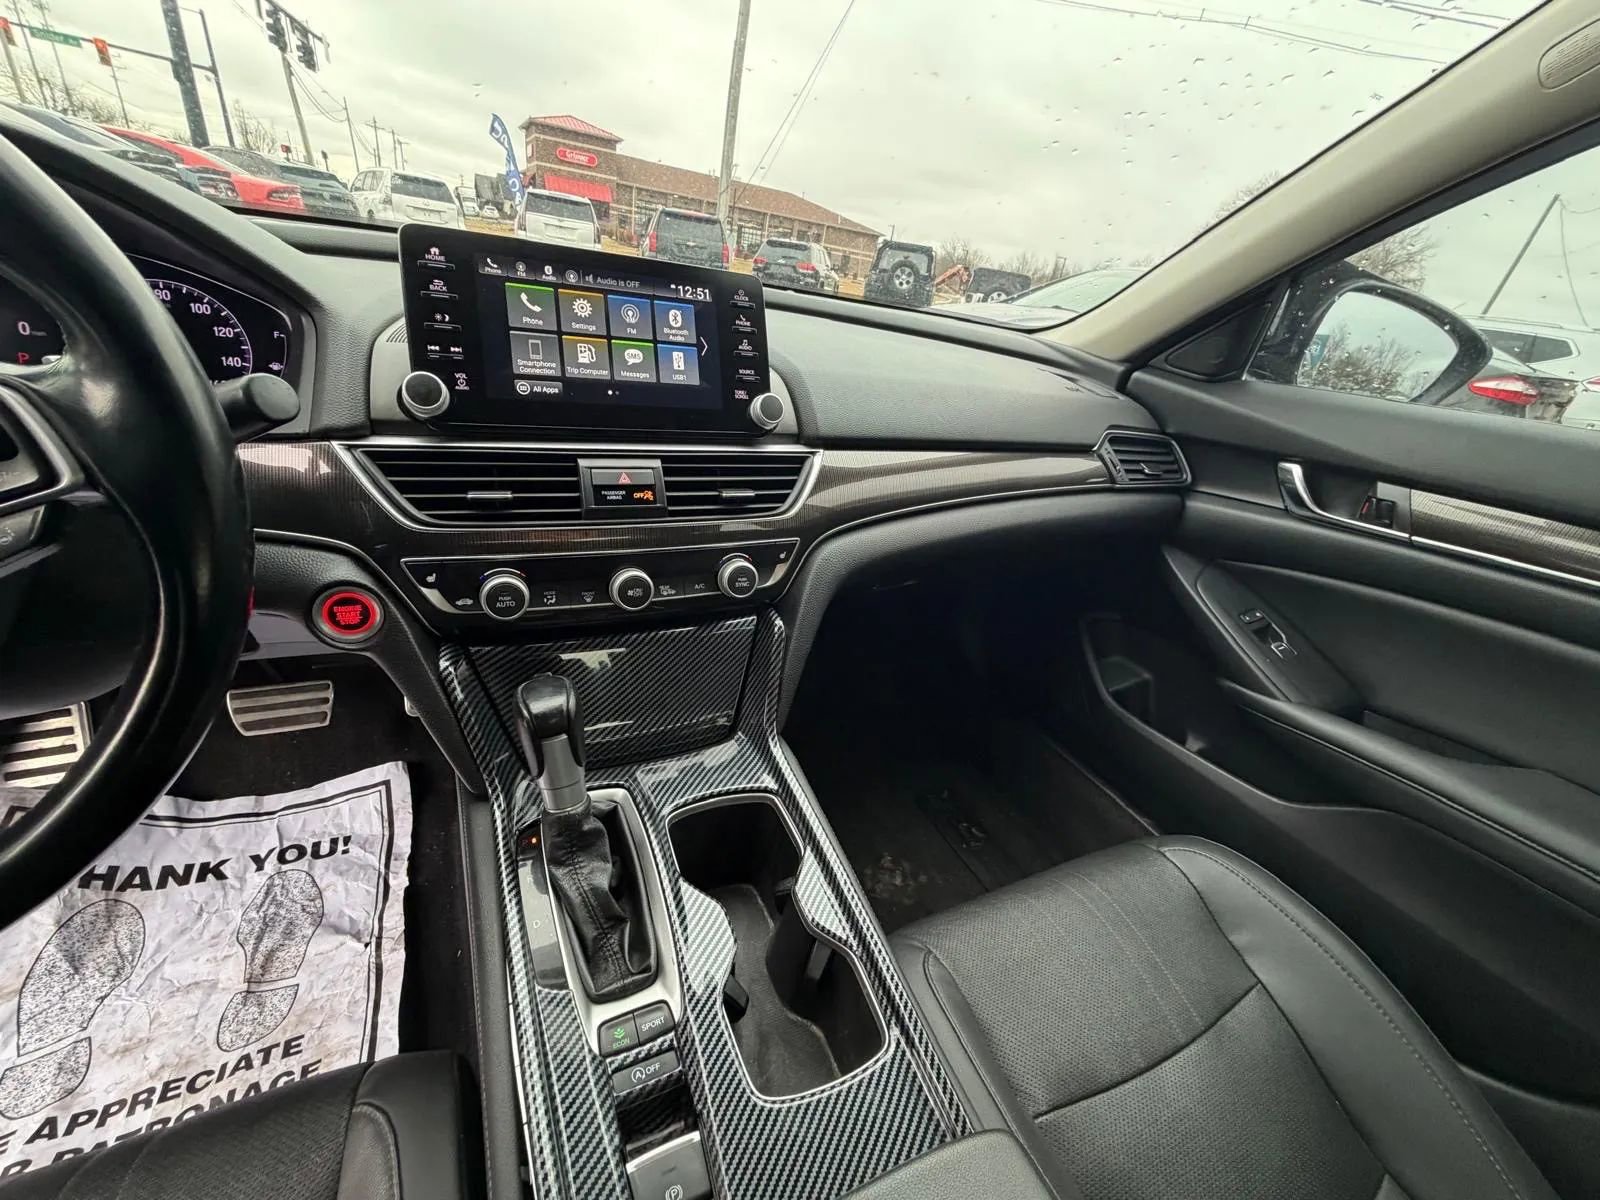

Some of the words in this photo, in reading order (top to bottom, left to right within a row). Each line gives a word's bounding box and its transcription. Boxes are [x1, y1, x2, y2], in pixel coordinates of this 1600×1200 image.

[425, 253, 446, 262] HOME
[484, 266, 502, 274] Phone
[596, 277, 618, 287] Audio
[618, 280, 625, 288] is
[626, 280, 641, 289] OFF
[429, 284, 448, 293] BACK
[677, 284, 711, 301] 12:51
[734, 294, 749, 302] CLOCK
[189, 302, 212, 315] 100
[522, 316, 544, 326] Phone
[735, 319, 751, 327] PHONE
[17, 320, 31, 336] 0
[571, 321, 597, 332] Settings
[626, 327, 637, 335] FM
[663, 327, 689, 336] Bluetooth
[212, 325, 235, 339] 120
[273, 331, 280, 339] F
[17, 352, 30, 364] P
[220, 356, 242, 368] 140
[517, 358, 557, 368] Smartphone
[519, 366, 556, 375] Connection
[566, 366, 578, 375] Trip
[579, 367, 609, 376] Computer
[620, 369, 650, 379] Messages
[533, 385, 542, 394] All
[542, 386, 559, 395] Apps
[495, 600, 516, 608] AUTO
[77, 857, 233, 893] HANK
[249, 834, 353, 873] YOU!
[641, 1016, 666, 1032] SPORT
[612, 1037, 630, 1050] ECON
[645, 1062, 662, 1076] OFF
[23, 1033, 306, 1146] APPRECIATE
